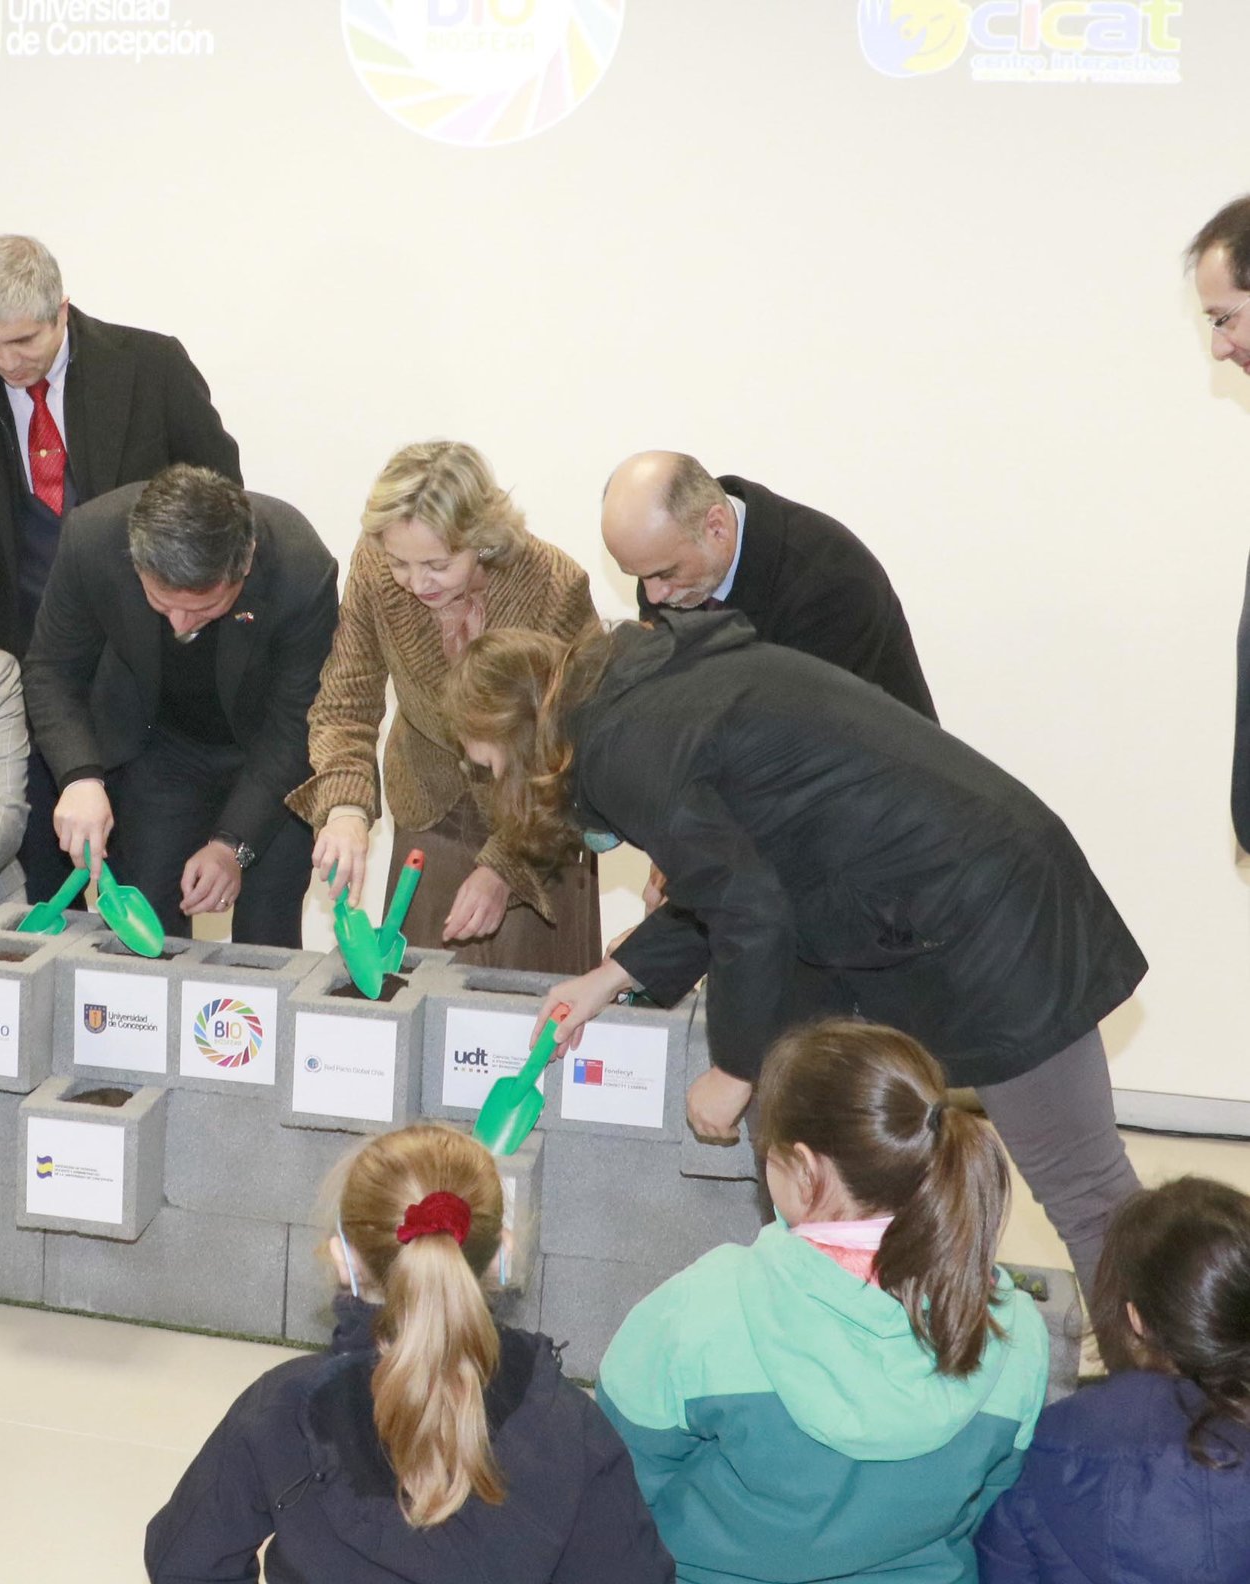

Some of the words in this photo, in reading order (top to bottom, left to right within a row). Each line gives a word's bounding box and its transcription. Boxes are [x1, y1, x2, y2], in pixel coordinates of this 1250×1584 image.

[6, 23, 40, 55] de
[46, 21, 215, 62] Concepción
[108, 1011, 148, 1023] Universidad
[215, 1020, 242, 1040] BIO
[454, 1047, 488, 1067] udt
